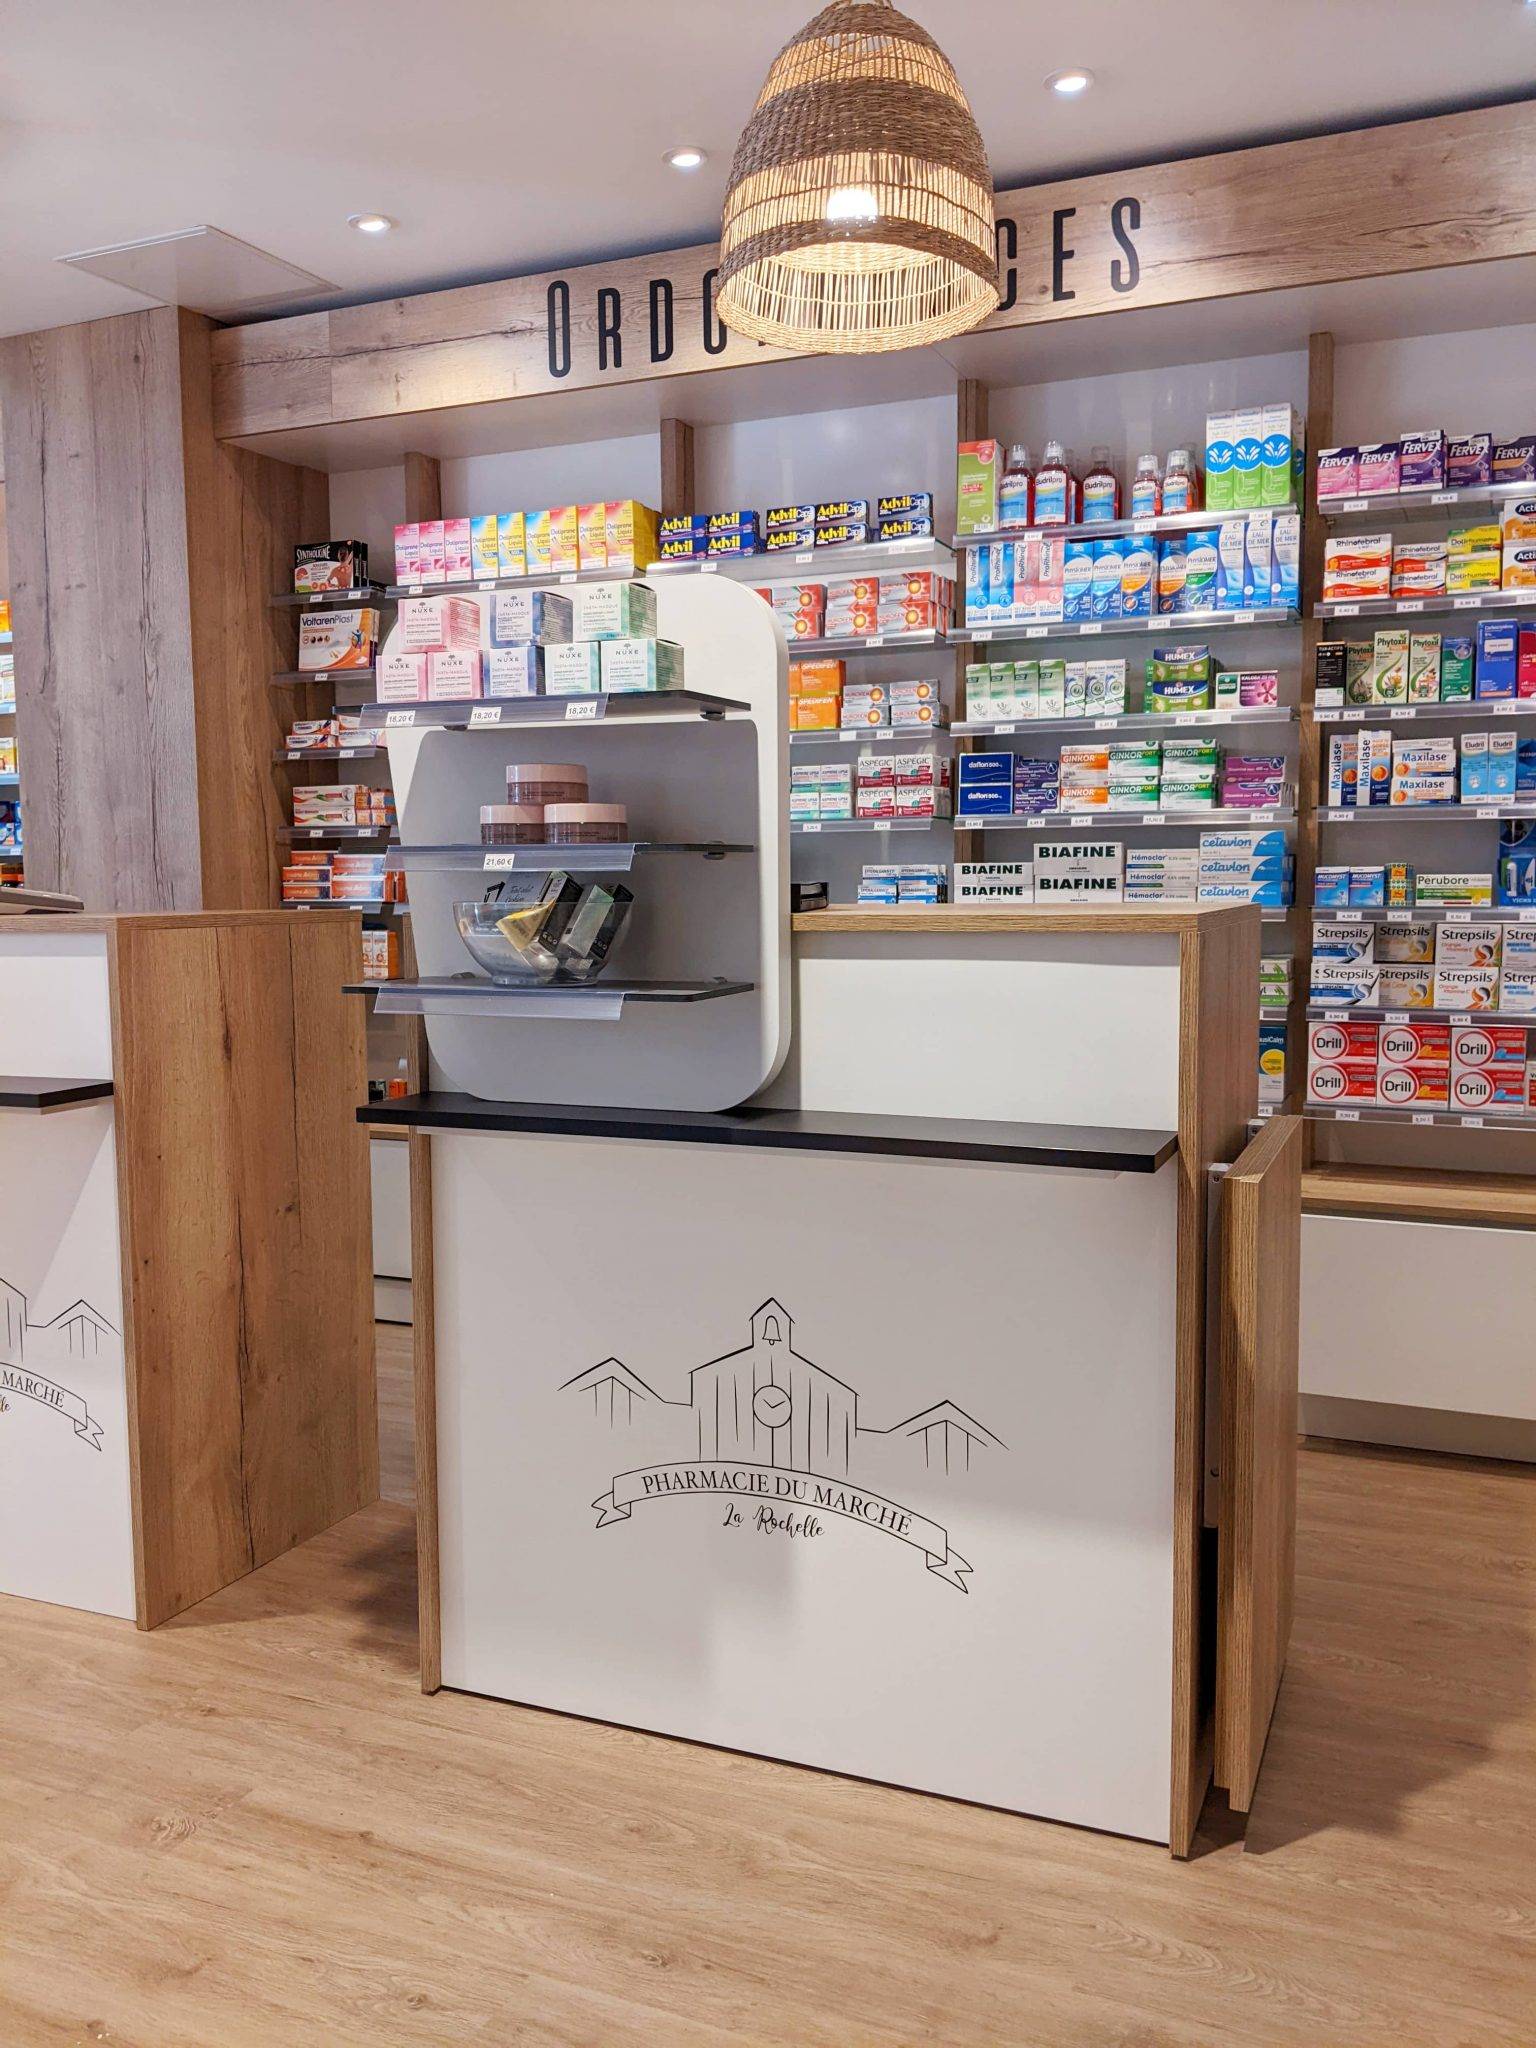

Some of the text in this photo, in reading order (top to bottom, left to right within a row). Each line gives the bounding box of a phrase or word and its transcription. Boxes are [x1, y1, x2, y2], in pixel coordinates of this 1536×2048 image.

[547, 197, 1141, 378] ORDOCES
[1402, 439, 1443, 454] FERVEX
[1450, 443, 1489, 457] FERVEX
[1495, 445, 1535, 459] FERVEX
[1319, 455, 1354, 468] FERVEX
[1360, 451, 1396, 464] FERVEX
[660, 516, 692, 531] Advil
[709, 512, 740, 527] Advil
[661, 539, 693, 554] Advil
[708, 535, 740, 549] Advil
[1377, 637, 1407, 647] Phytoxil
[1412, 639, 1439, 648] Phytoxil
[1165, 651, 1196, 661] HUMEX
[1164, 685, 1195, 695] HUMEX
[473, 712, 491, 720] 18,20
[568, 707, 588, 715] 18,20
[389, 715, 406, 723] 18,20
[1063, 754, 1095, 763] GINKOR
[1110, 751, 1142, 760] GINKOR
[1165, 749, 1199, 758] GINKOR
[1401, 752, 1447, 762] Maxilase
[1330, 742, 1342, 789] Maxilase
[1359, 739, 1371, 787] Maxilase
[1109, 785, 1141, 795] GINKOR
[1161, 783, 1195, 792] GINKOR
[1399, 779, 1445, 789] Maxilase
[1063, 788, 1095, 797] GINKOR
[1038, 846, 1116, 859] BIAFINE
[485, 857, 513, 867] 21,60 €
[962, 864, 1023, 875] BIAFINE
[1039, 878, 1117, 890] BIAFINE
[1417, 875, 1469, 885] Perubore
[961, 886, 1023, 896] BIAFINE
[1317, 927, 1369, 940] Strepsils
[1380, 926, 1430, 938] Strepsils
[1441, 929, 1496, 942] Strepsils
[1322, 968, 1374, 981] Strepsils
[1379, 968, 1429, 981] Strepsils
[1439, 971, 1493, 984] Strepsils
[1316, 1037, 1342, 1049] Drill
[1386, 1040, 1413, 1053] Drill
[1459, 1043, 1487, 1056] Drill
[1315, 1076, 1341, 1089] Drill
[1385, 1079, 1411, 1092] Drill
[1459, 1082, 1487, 1096] Drill
[2, 1370, 65, 1408] MARCHÉ
[641, 1469, 913, 1537] PHARMACIE DU MARCHÉ
[722, 1502, 826, 1539] La Rochelle
